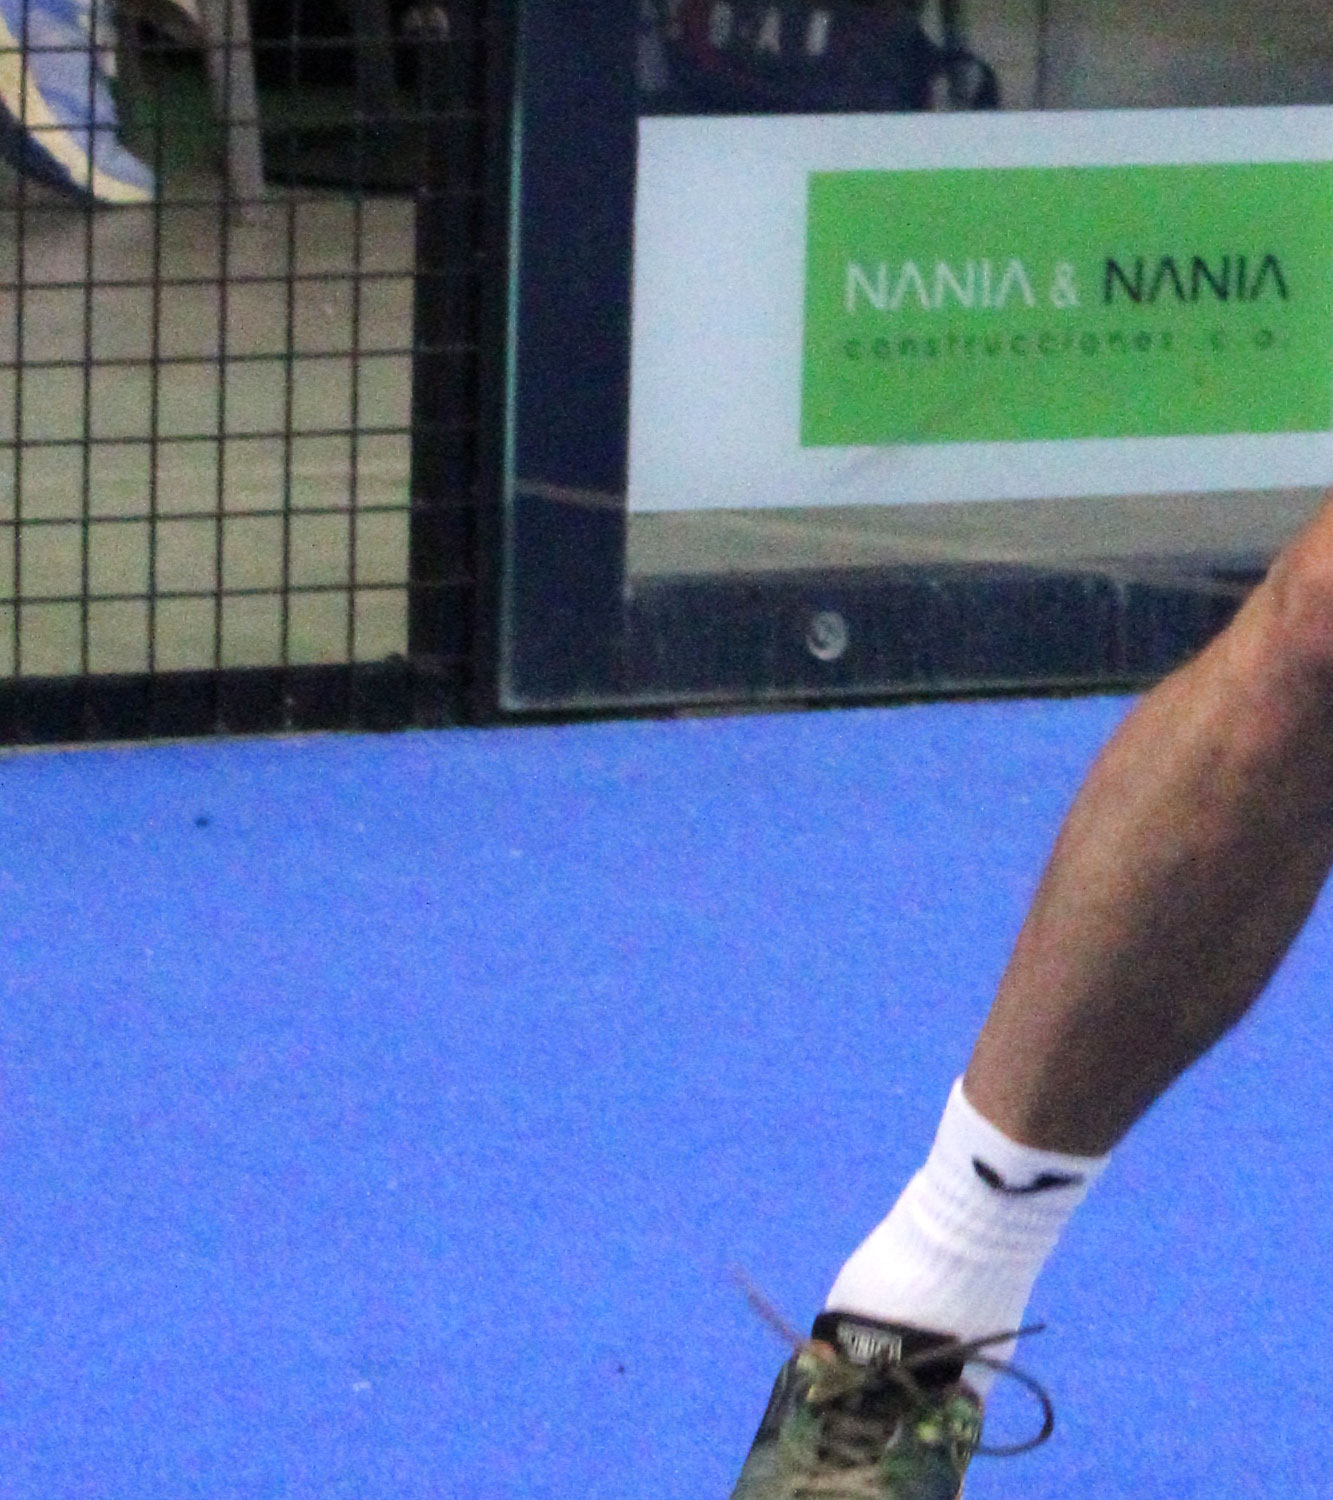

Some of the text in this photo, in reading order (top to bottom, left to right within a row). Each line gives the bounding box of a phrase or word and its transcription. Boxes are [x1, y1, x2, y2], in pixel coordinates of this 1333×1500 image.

[847, 253, 1289, 313] NANIA & NANIA
